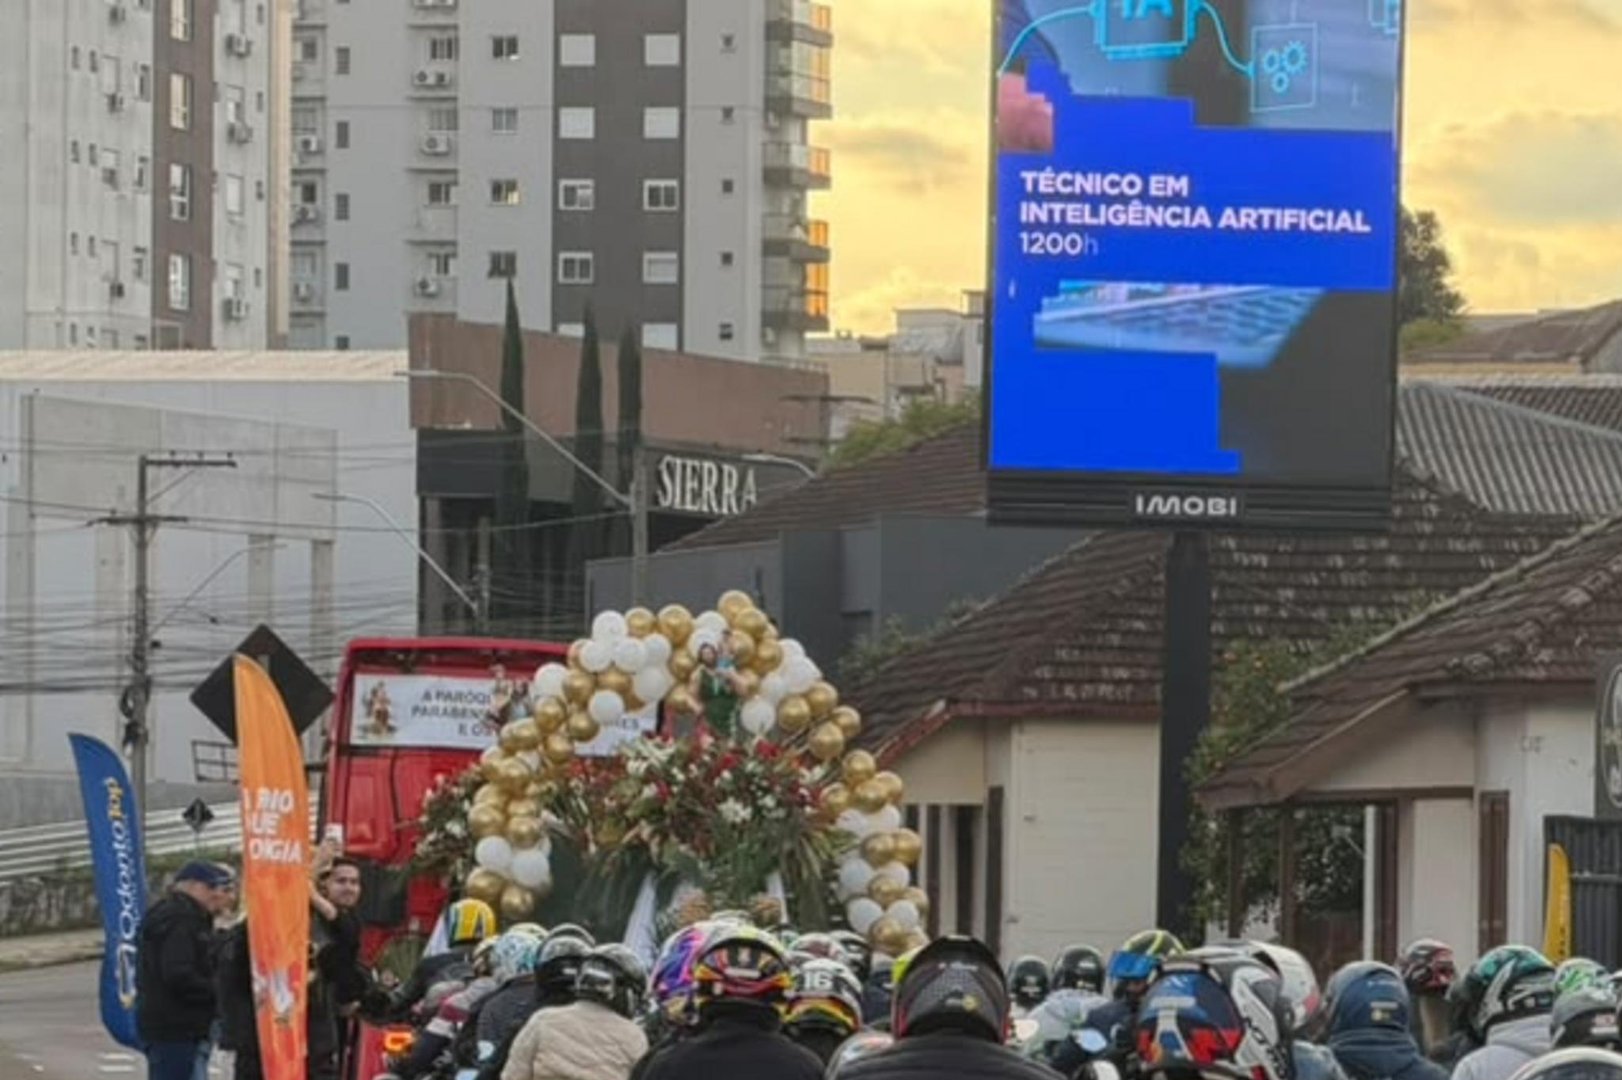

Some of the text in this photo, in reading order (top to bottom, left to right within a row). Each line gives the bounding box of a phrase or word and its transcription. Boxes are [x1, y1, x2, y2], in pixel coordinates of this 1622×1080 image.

[1019, 166, 1189, 198] TÉCNICO EM
[1019, 199, 1372, 233] INTELIGÊNCIA ARTIFICIAL
[657, 455, 757, 515] SIERRA
[1135, 494, 1238, 516] IMOBI
[435, 687, 491, 706] PARÓQ
[411, 705, 486, 721] PARABEN
